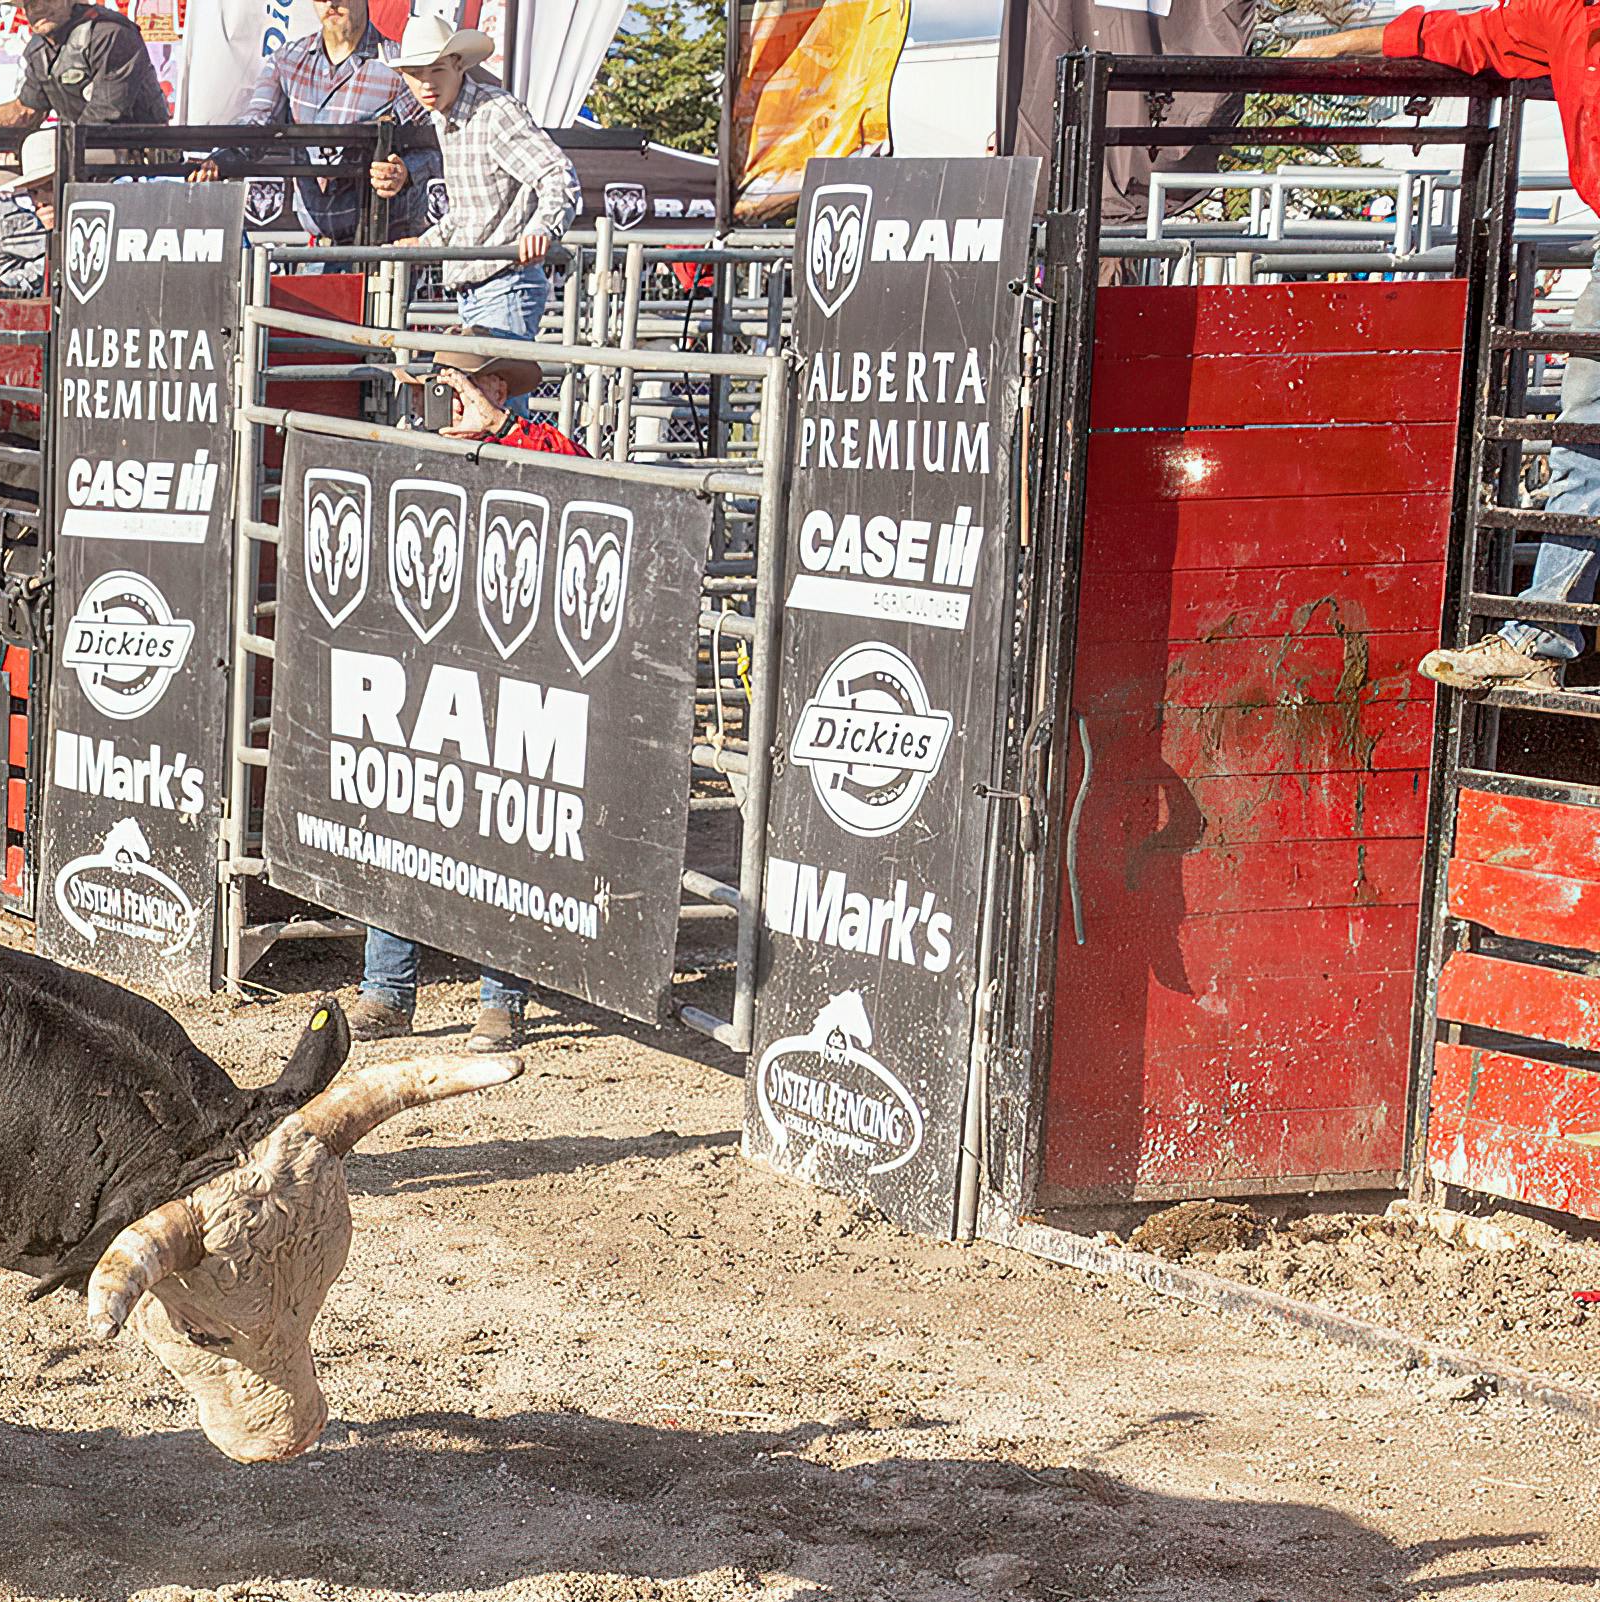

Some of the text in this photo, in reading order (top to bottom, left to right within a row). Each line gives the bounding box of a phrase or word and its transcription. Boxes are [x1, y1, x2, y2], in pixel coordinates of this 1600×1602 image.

[653, 199, 716, 218] RA
[116, 228, 225, 262] RAM
[871, 218, 1004, 262] RAM
[65, 328, 214, 370] ALBERTA
[63, 379, 218, 423] PREMIUM
[807, 350, 986, 404] ALBERTA
[800, 418, 990, 474] PREMIUM
[67, 457, 175, 509] CASE
[800, 509, 932, 582] CASE
[75, 630, 175, 658] Dickies
[330, 647, 590, 789] RAM
[809, 717, 932, 759] Dickies
[79, 735, 205, 815] Mark's
[330, 739, 585, 862] RODEO TOUR
[297, 811, 599, 940] WWW.RAMRODEOONTARIO.COM
[69, 874, 122, 916] SYSTEM
[124, 887, 183, 933] FENCING
[791, 863, 953, 973] Mark's
[769, 1060, 905, 1146] SYSTEM FENCING
